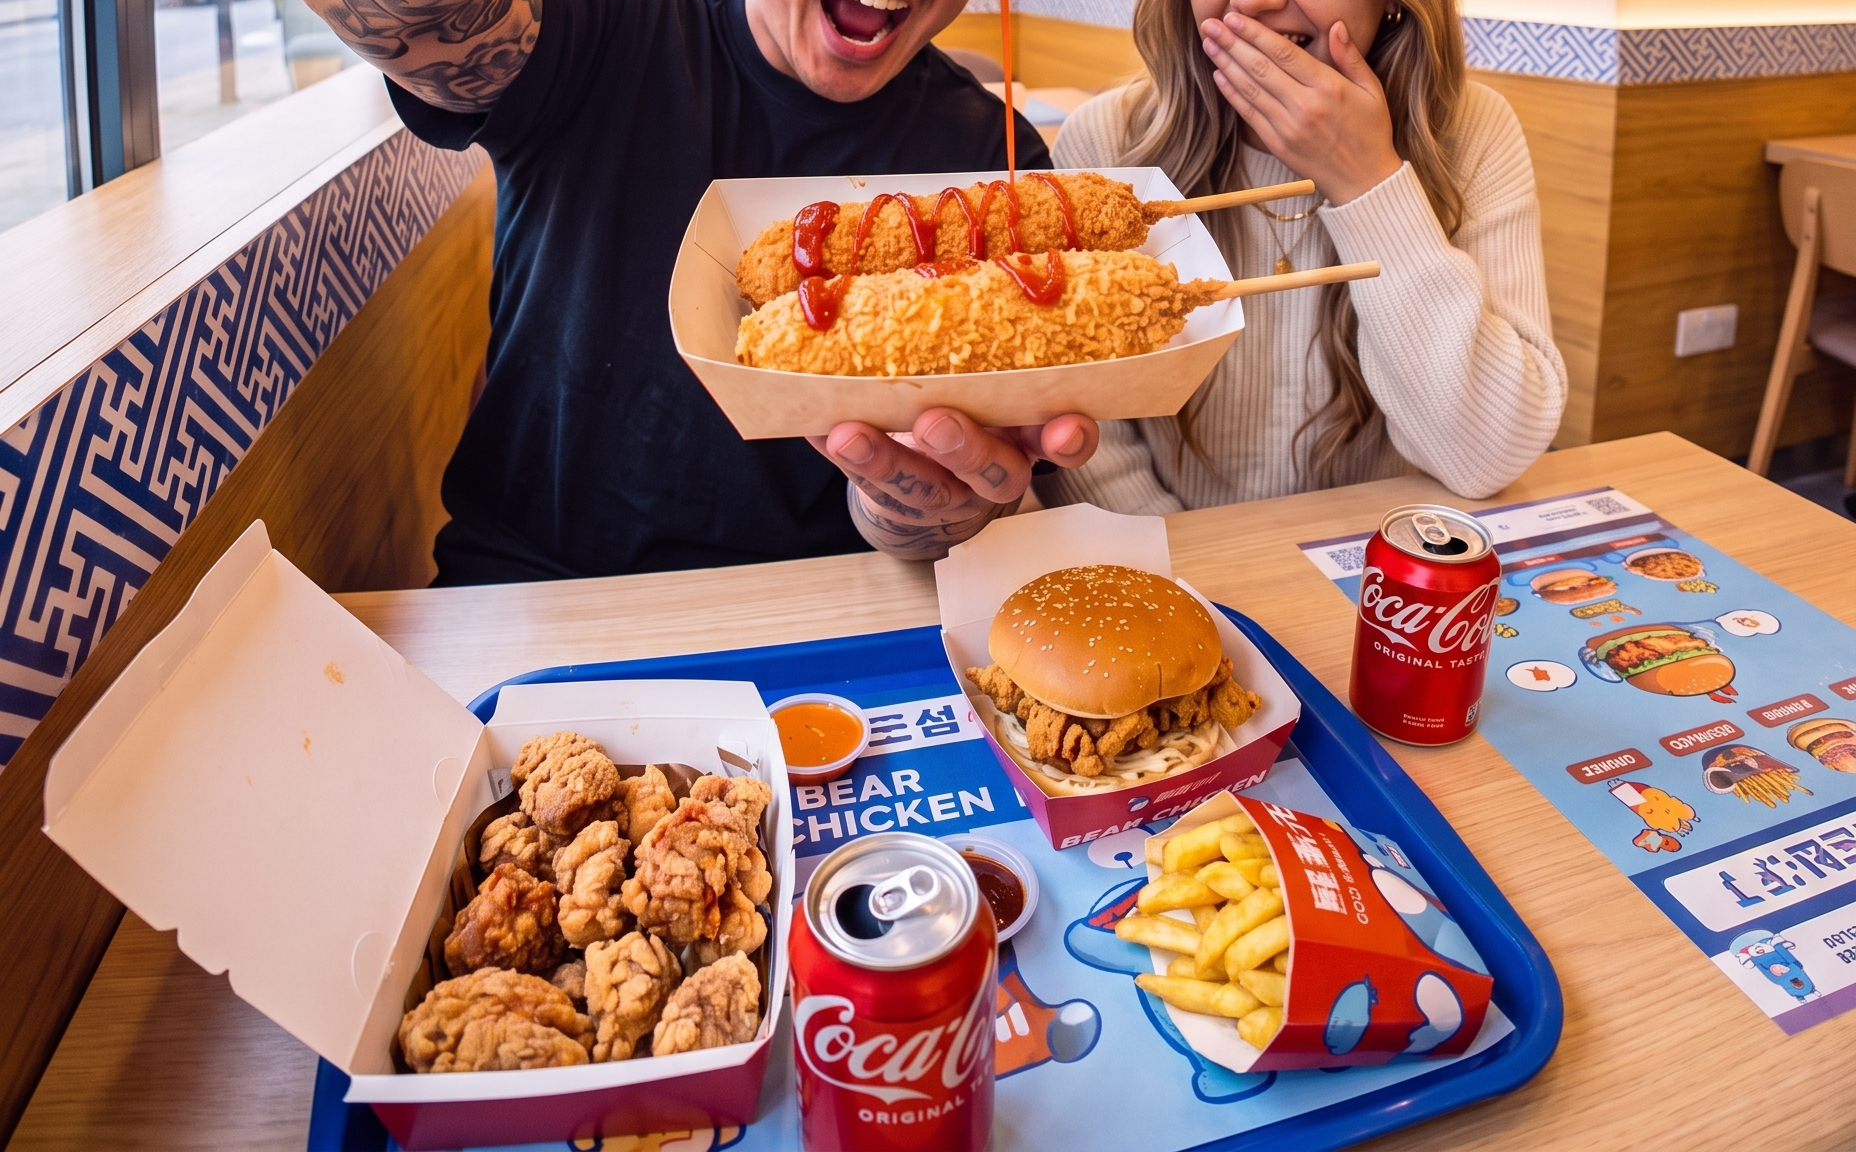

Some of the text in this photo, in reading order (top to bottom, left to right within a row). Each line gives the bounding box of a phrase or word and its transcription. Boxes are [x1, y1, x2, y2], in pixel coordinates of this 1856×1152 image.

[1359, 566, 1500, 654] Coca-Col
[1374, 641, 1443, 669] ORIGINAL
[796, 769, 924, 810] BEAR
[858, 1094, 965, 1125] ORIGINAL
